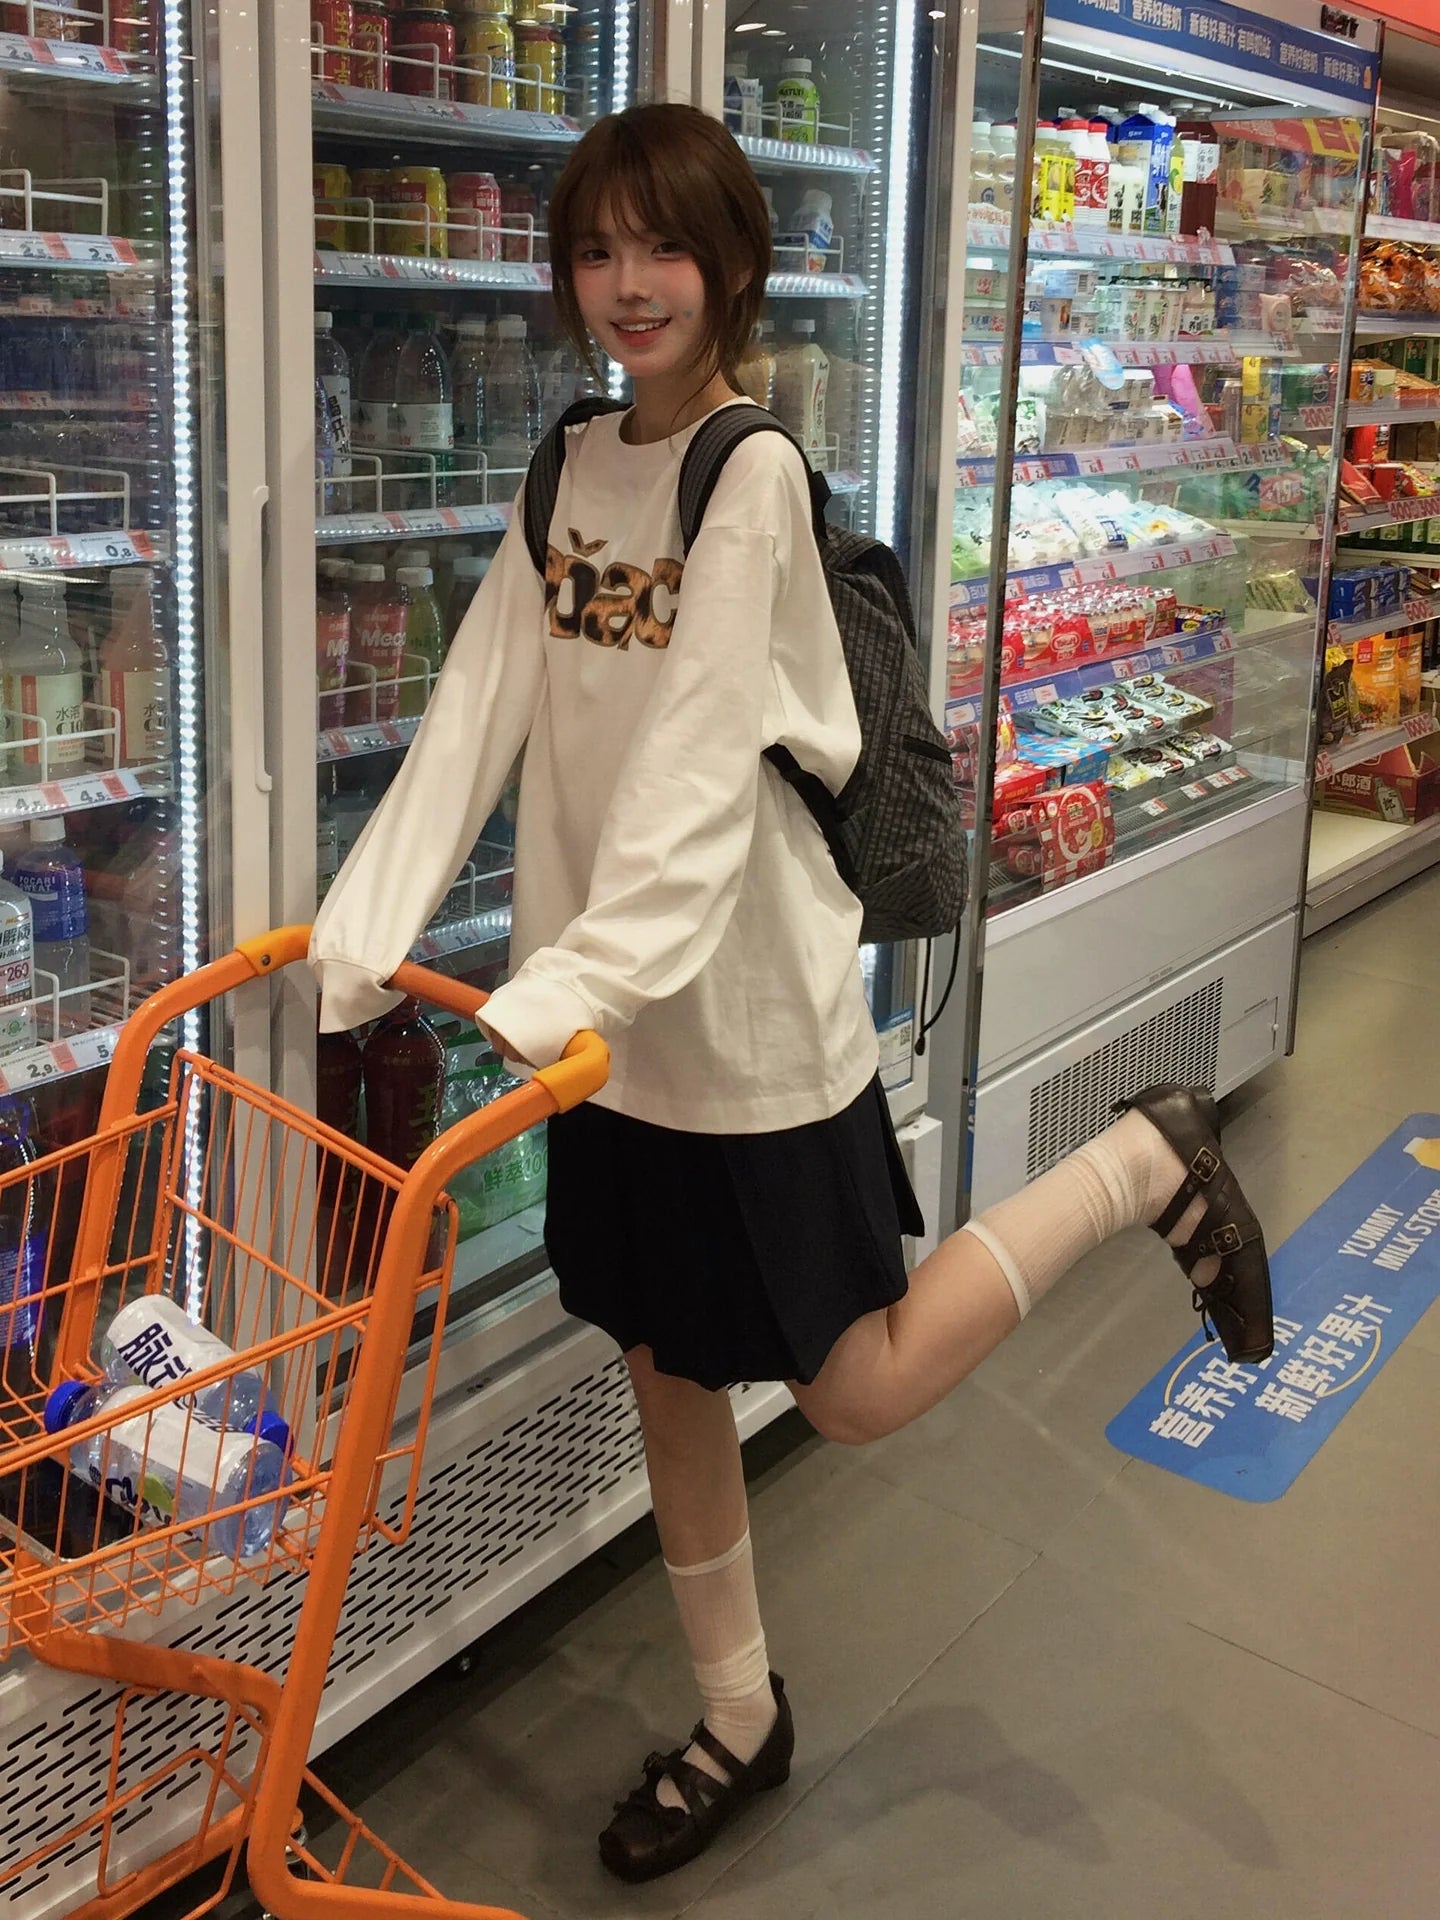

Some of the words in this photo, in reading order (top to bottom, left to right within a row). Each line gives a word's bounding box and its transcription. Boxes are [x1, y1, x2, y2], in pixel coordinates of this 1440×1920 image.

[1338, 1203, 1404, 1258] YUMMY
[1372, 1231, 1424, 1271] MILK
[1255, 1293, 1393, 1423] 新鲜好果汁
